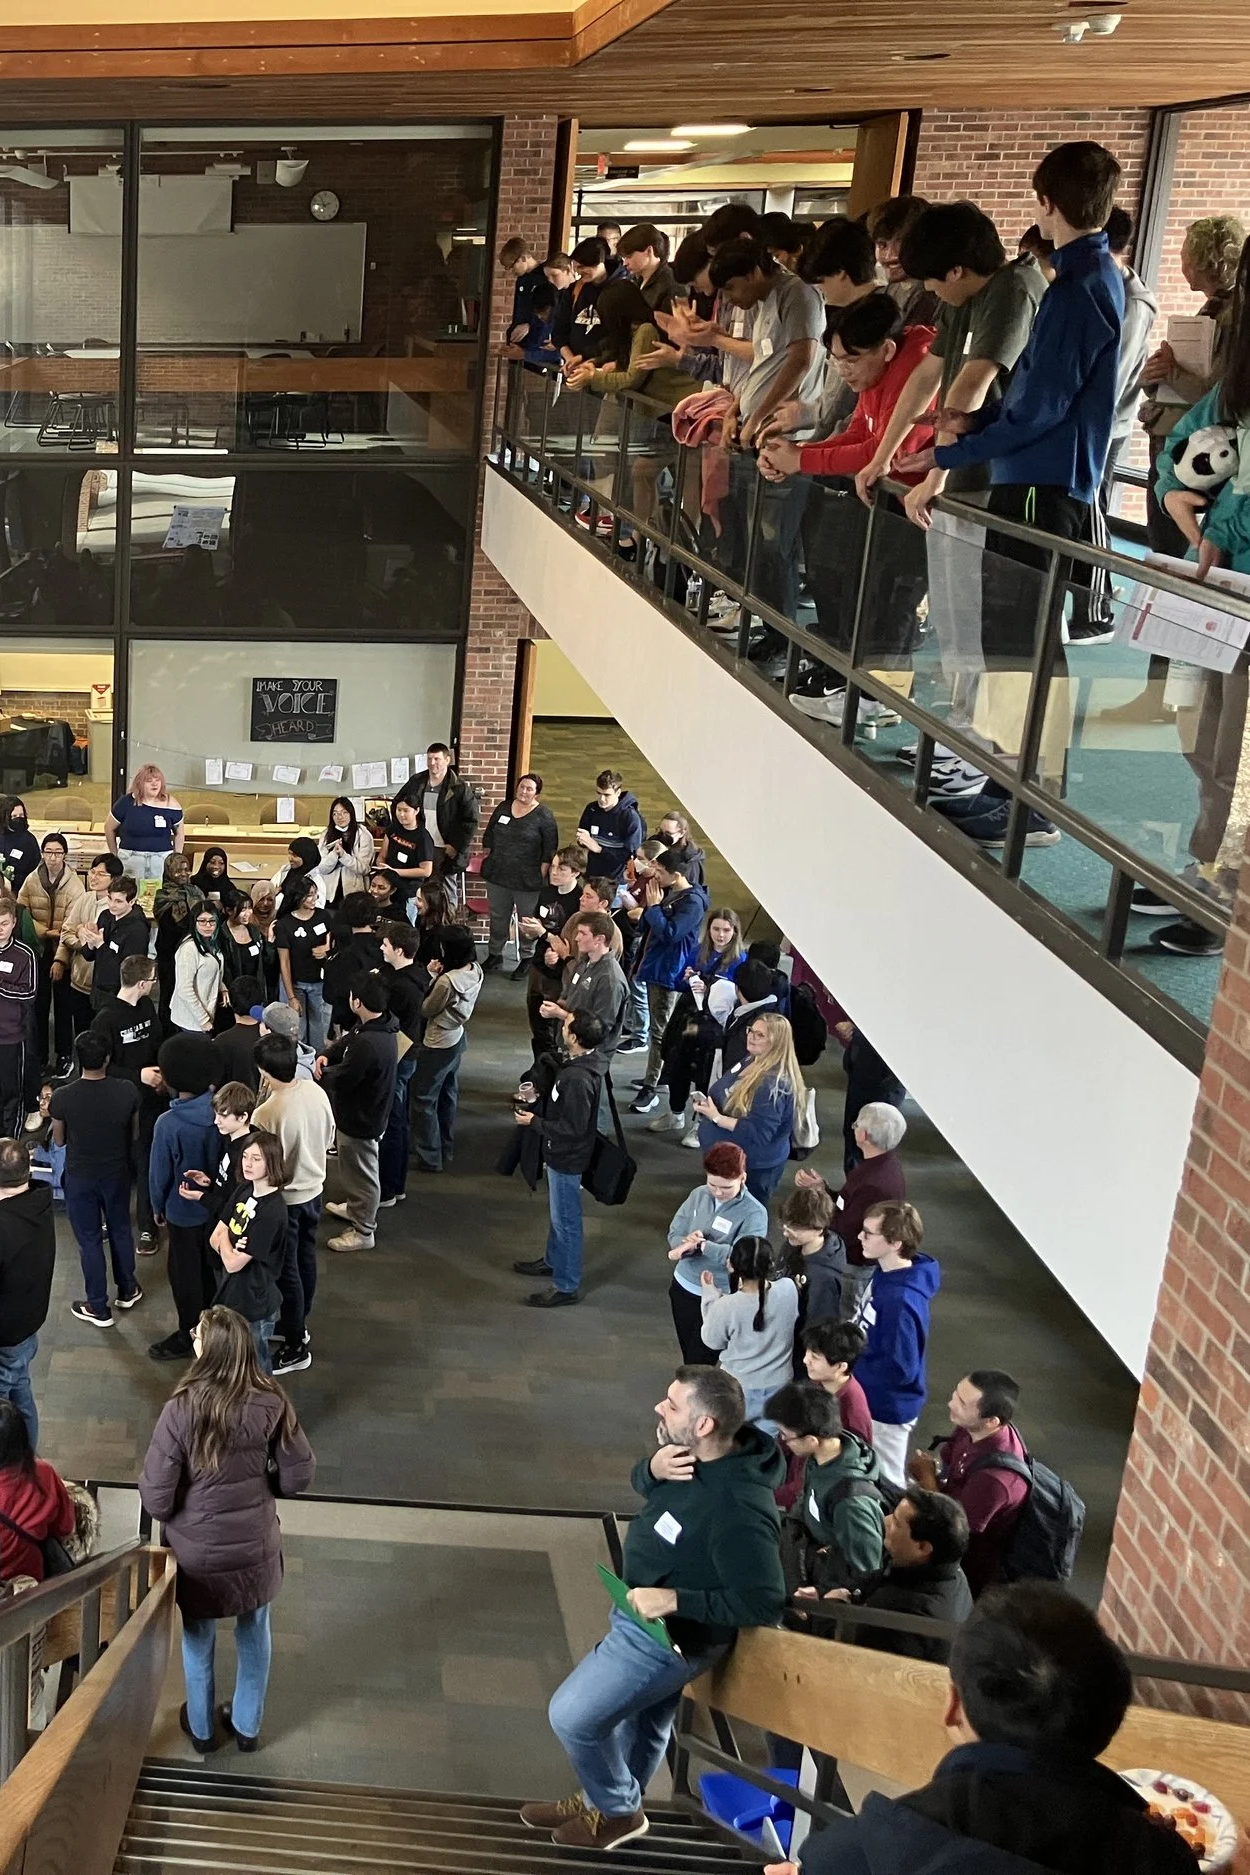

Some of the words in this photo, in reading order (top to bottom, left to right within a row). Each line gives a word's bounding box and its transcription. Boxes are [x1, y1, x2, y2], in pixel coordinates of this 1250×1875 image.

[256, 680, 284, 692] MAKE
[292, 679, 323, 692] YOUR
[262, 692, 334, 715] VOICE
[271, 719, 314, 736] HEARD
